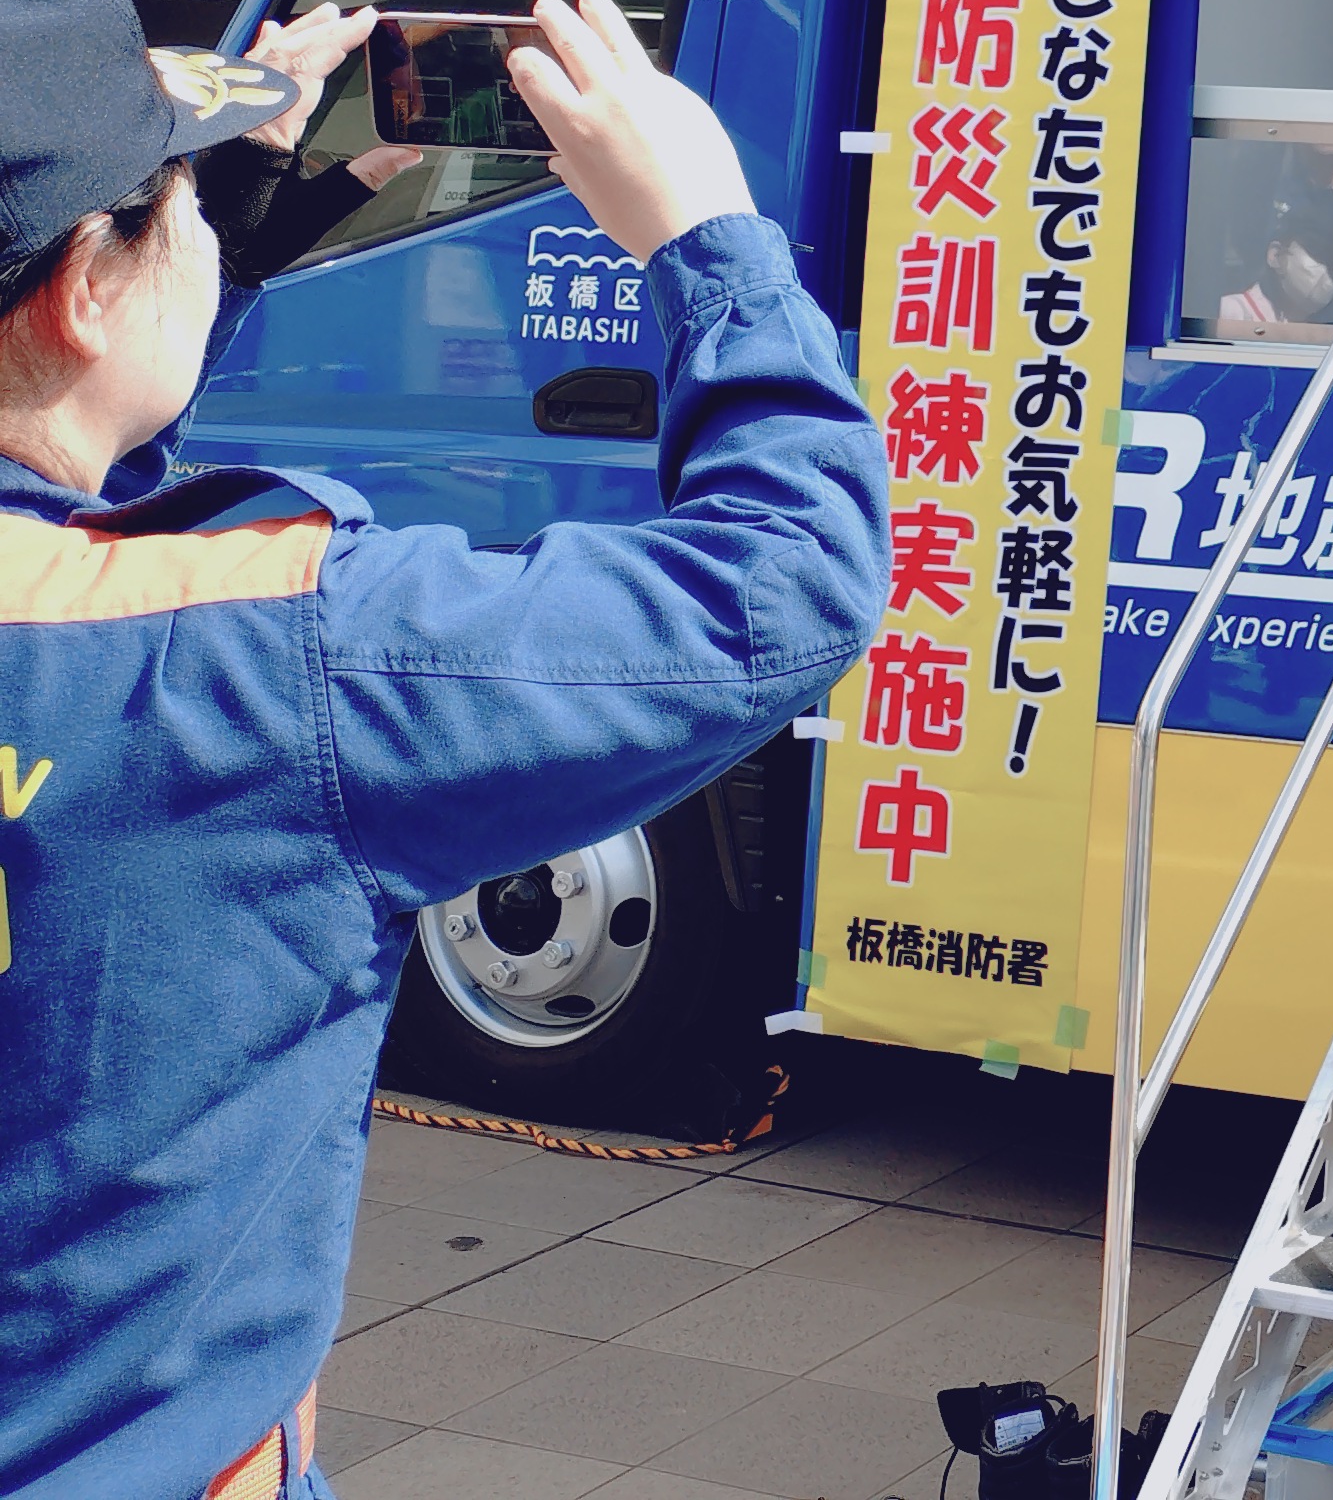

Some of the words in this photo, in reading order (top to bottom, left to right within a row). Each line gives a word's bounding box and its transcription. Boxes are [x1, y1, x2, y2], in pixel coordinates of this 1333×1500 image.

[524, 272, 644, 312] 板橋区
[520, 314, 639, 345] ITABASHI
[846, 917, 1049, 988] 板橋消防署
